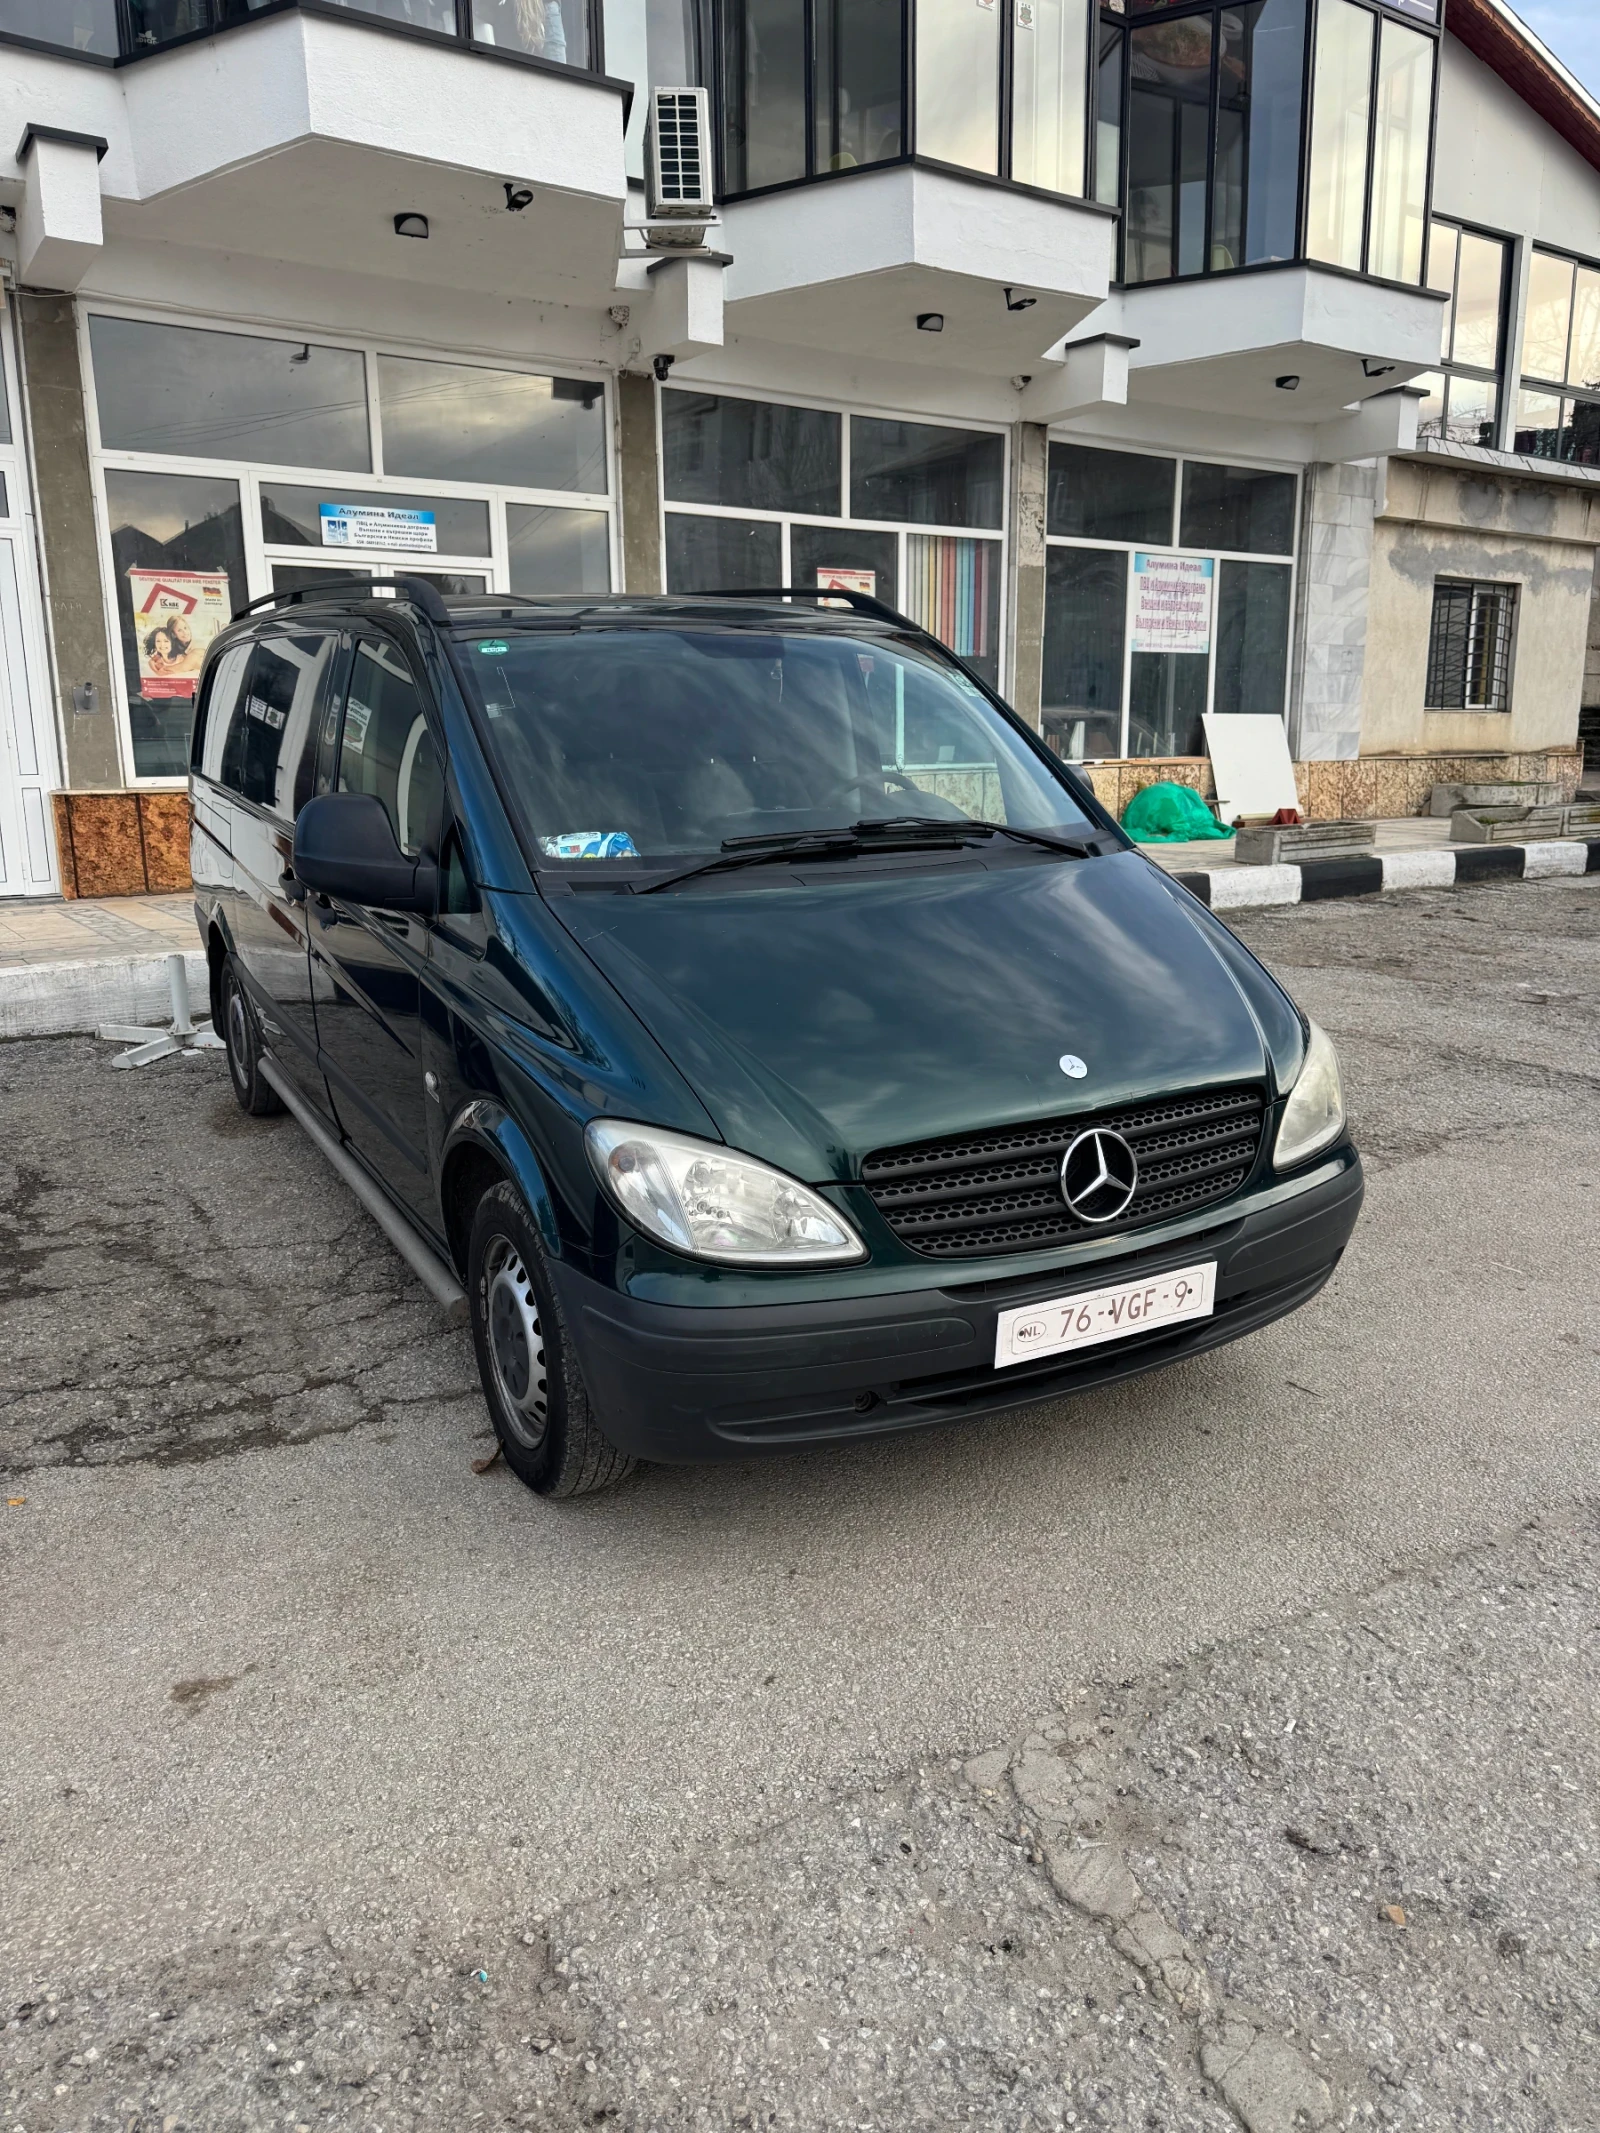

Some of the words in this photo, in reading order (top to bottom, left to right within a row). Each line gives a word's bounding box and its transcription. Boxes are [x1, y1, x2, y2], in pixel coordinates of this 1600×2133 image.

[339, 508, 385, 518] Алумина
[387, 511, 419, 520] Идеал
[1147, 559, 1178, 571] Алумина
[1180, 562, 1202, 571] Идеал
[1023, 1326, 1040, 1338] NL
